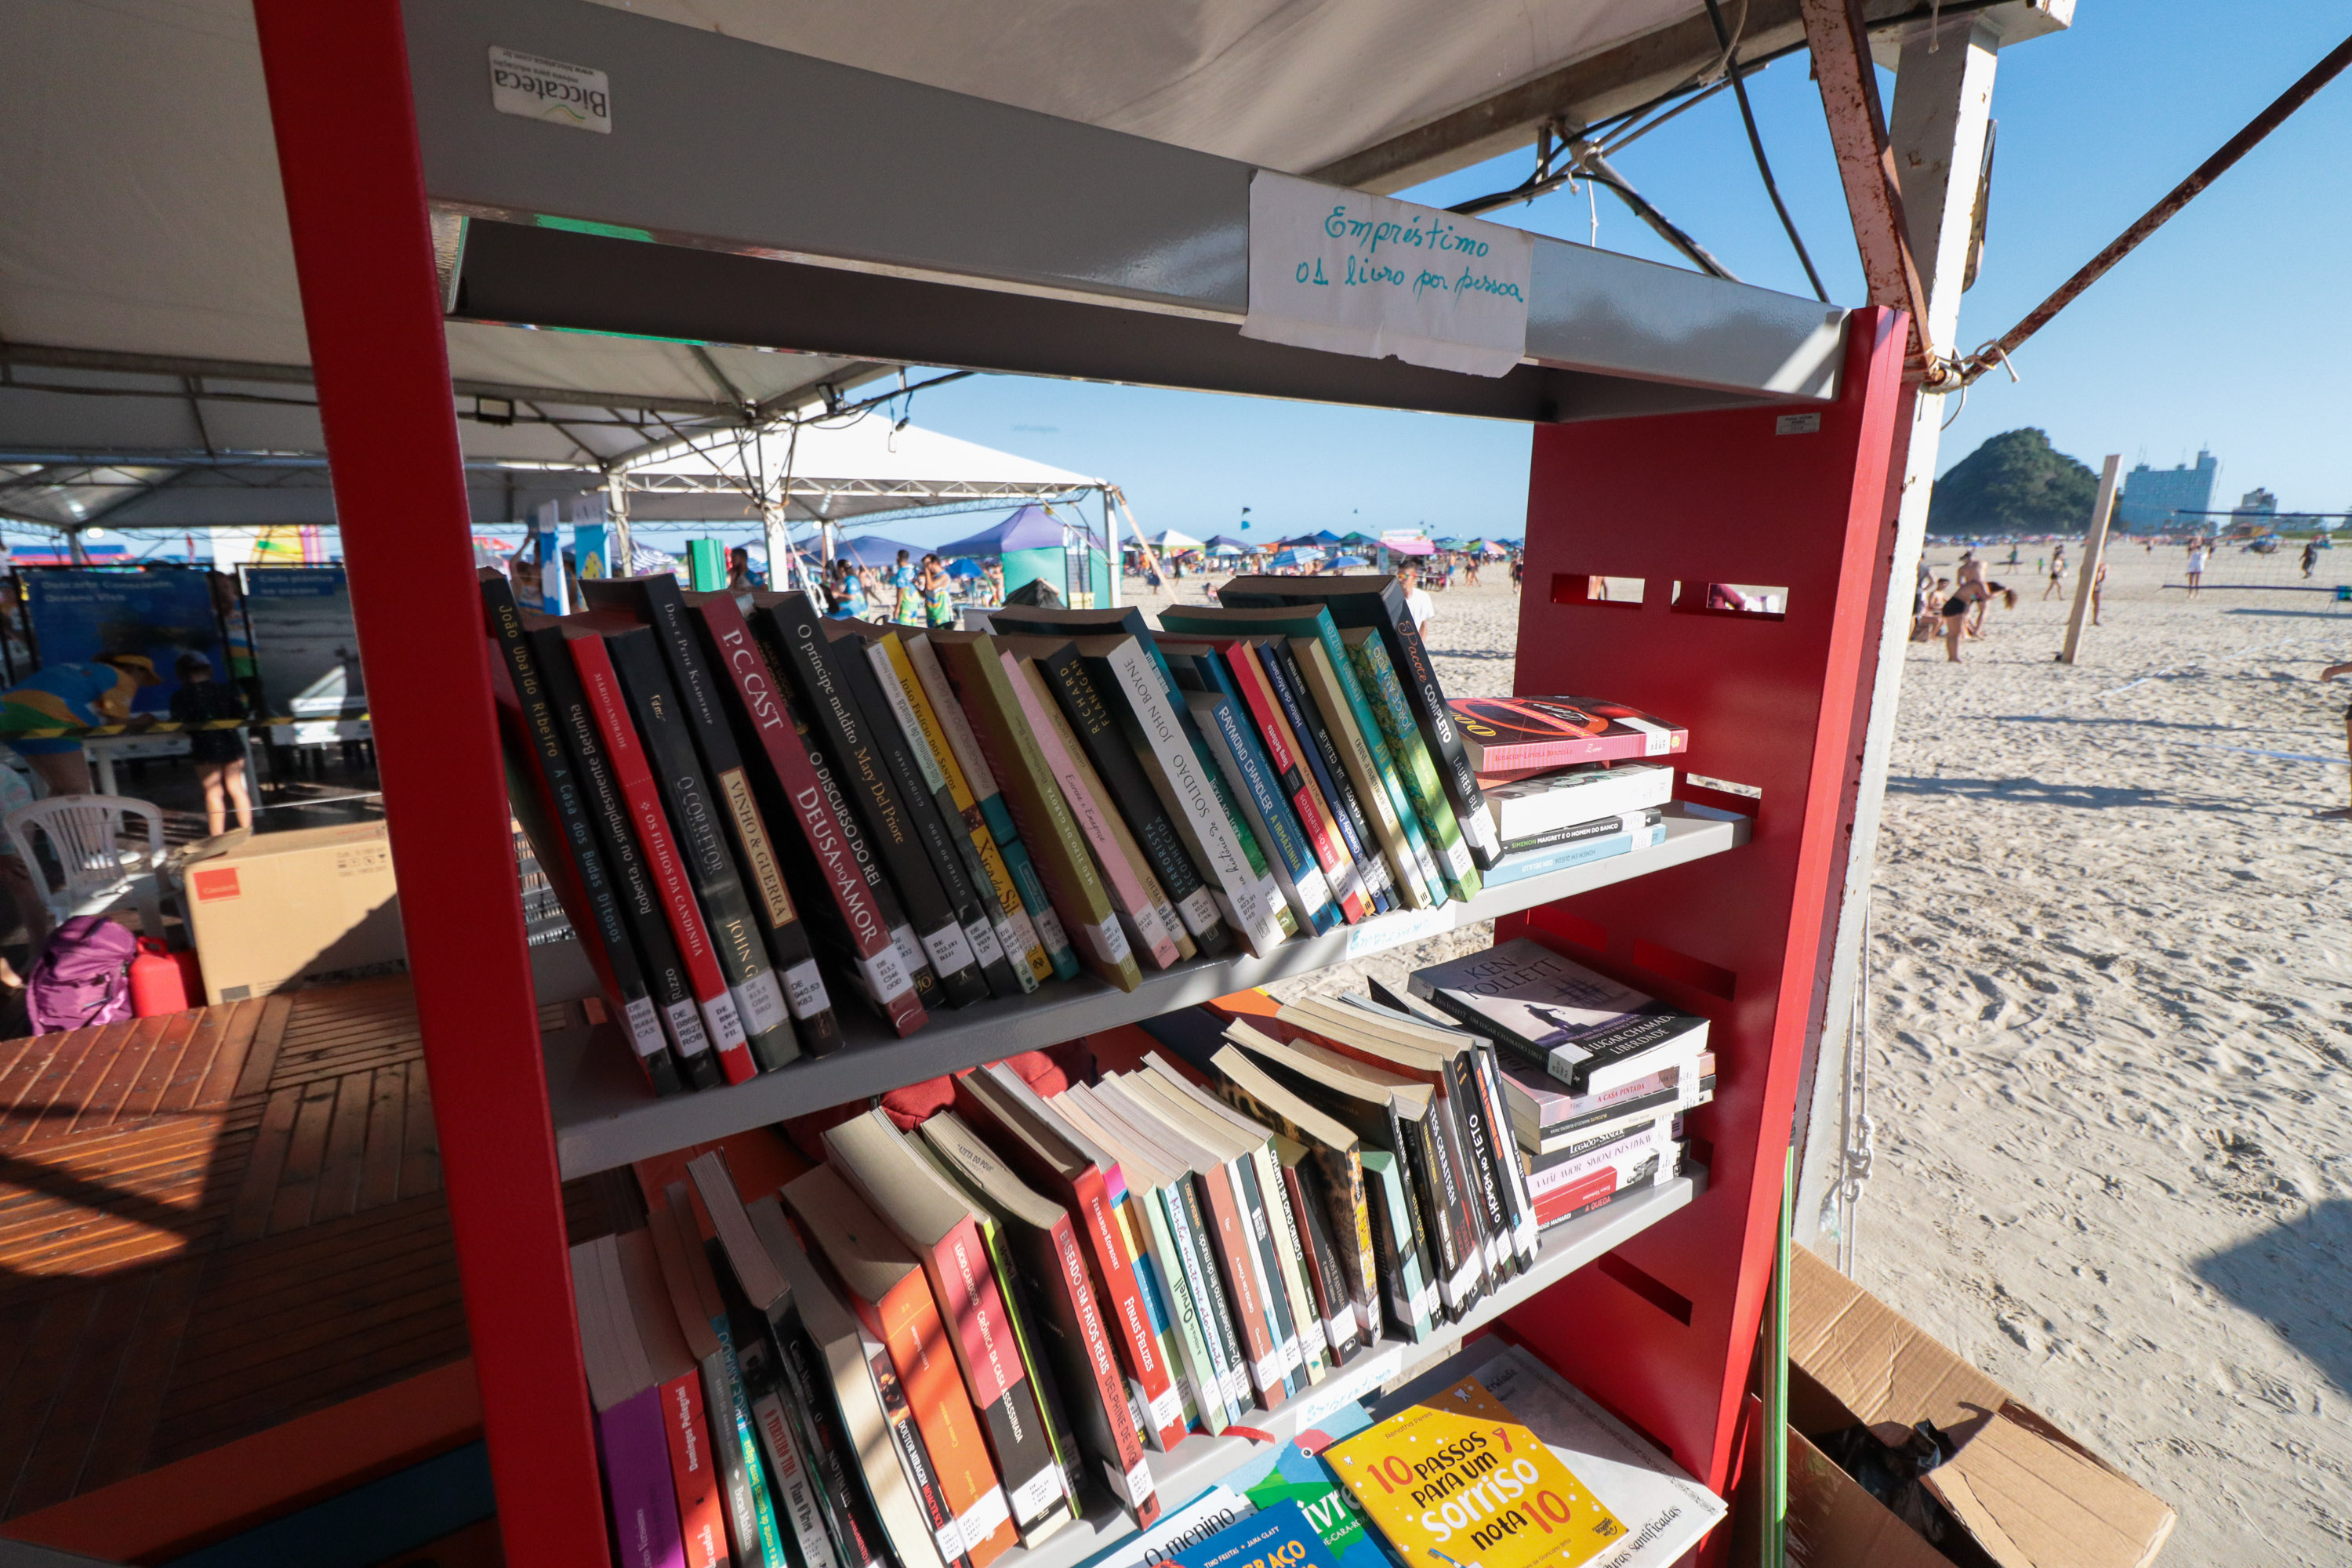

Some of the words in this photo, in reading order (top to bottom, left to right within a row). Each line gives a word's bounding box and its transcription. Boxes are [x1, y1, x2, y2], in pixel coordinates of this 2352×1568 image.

[495, 69, 607, 118] Biccateca
[1325, 206, 1489, 257] Empréstimo
[1345, 256, 1404, 285] livro
[1413, 270, 1447, 304] por
[499, 605, 517, 638] João
[798, 624, 812, 638] O
[1327, 620, 1345, 659] AGUZZOLI
[513, 646, 537, 695] Ubaldo
[800, 642, 834, 695] príncipe
[1124, 659, 1152, 704] BOYNE
[1270, 660, 1286, 692] Moraes
[1344, 662, 1362, 702] FERNANDO
[1374, 648, 1394, 693] AMADO
[744, 673, 784, 729] CAST
[1061, 667, 1100, 734] RICHARD
[1070, 659, 1110, 727] FLANAGAN
[1284, 691, 1292, 702] de
[532, 702, 558, 757] Ribeiro
[571, 704, 596, 755] Betinha
[829, 696, 858, 744] maldito
[1148, 706, 1174, 743] JOHN
[1290, 702, 1302, 728] Heitor
[1392, 694, 1411, 731] JORGE
[1219, 706, 1248, 761] RAYMOND
[1268, 724, 1283, 752] Bellotto
[1319, 728, 1337, 763] CIDADE
[1425, 684, 1452, 744] COMPLETO
[1453, 756, 1472, 796] LAUREN
[554, 769, 567, 778] A
[854, 746, 876, 782] Mary
[895, 750, 909, 777] VIARO
[1279, 750, 1289, 768] Tony
[871, 782, 887, 807] Del
[901, 678, 914, 702] JOÃO
[913, 703, 931, 737] FELÍCIO
[929, 739, 940, 756] DOS
[938, 758, 956, 789] SANTOS
[978, 837, 996, 878] Xica
[908, 780, 924, 807] GUIDO
[1173, 754, 1210, 818] SOLIDÃO
[1243, 759, 1273, 815] CHANDLER
[560, 784, 577, 815] Casa
[590, 757, 627, 843] simplesmente
[1046, 787, 1065, 823] GAROTA
[1345, 784, 1362, 819] GAROTA
[572, 823, 587, 844] dos
[607, 707, 626, 750] ANDRADE
[645, 815, 659, 830] OS
[652, 833, 674, 875] FILHOS
[668, 877, 681, 894] DA
[675, 895, 703, 957] CANDINHA
[810, 752, 822, 765] O
[817, 767, 857, 838] DISCURSO
[851, 839, 869, 862] DO
[863, 863, 880, 887] REI
[883, 806, 904, 844] Priore
[928, 823, 942, 848] MEDO
[1064, 826, 1073, 840] DE
[1270, 815, 1277, 824] A
[1340, 821, 1360, 854] Givenchy
[1512, 840, 1537, 848] SIMENON
[1537, 835, 1561, 844] MAIGRET
[1571, 829, 1591, 838] HOMEM
[1600, 823, 1618, 832] BANCO
[621, 844, 633, 861] ou
[729, 781, 757, 834] VINHO
[750, 839, 760, 849] &
[756, 853, 786, 918] GUERRA
[1071, 841, 1086, 864] TIPO
[1144, 824, 1183, 895] TERRORISTA
[1273, 822, 1301, 872] IRMÃZINHA
[583, 851, 603, 887] Budas
[683, 793, 723, 876] CORRETOR
[725, 919, 753, 963] JOHN
[948, 864, 962, 888] LIVRO
[628, 862, 652, 915] Roberta,
[597, 893, 621, 942] Ditosos
[790, 980, 804, 992] DE
[1457, 957, 1564, 1000] FOLLETT
[1465, 956, 1518, 981] KEN
[793, 982, 820, 1000] 940.53
[672, 1010, 687, 1020] DE
[1592, 1032, 1626, 1051] LUGAR
[1624, 1011, 1678, 1040] CHAMADO
[1610, 1028, 1669, 1054] LIBERDADE
[1603, 1091, 1618, 1101] CASA
[1620, 1083, 1645, 1097] PINTADA
[1469, 1114, 1484, 1157] TETO
[1271, 1149, 1283, 1185] LAMPIÃO
[1429, 1103, 1443, 1135] TESS
[1437, 1137, 1457, 1207] GERRITSEN
[1481, 1156, 1488, 1170] NO
[1279, 1185, 1287, 1197] DE
[1483, 1171, 1500, 1215] HOMEM
[1283, 1197, 1294, 1225] OLHO
[1550, 1214, 1571, 1226] MAINARDI
[1592, 1196, 1611, 1210] QUEDA
[1199, 1233, 1210, 1260] mundo
[1289, 1225, 1301, 1252] OUTRO
[1414, 1223, 1425, 1247] Toda
[954, 1243, 967, 1276] LÚCIO
[1060, 1229, 1082, 1287] BASEADO
[1296, 1252, 1303, 1261] O
[961, 1270, 979, 1306] CARDOSO
[1077, 1286, 1088, 1306] EM
[1092, 1196, 1107, 1236] FERNANDO
[1104, 1232, 1119, 1270] KOPROSKI
[1123, 1296, 1142, 1334] FINAIS
[1136, 1330, 1154, 1372] FELIZES
[1170, 1197, 1186, 1242] Minha
[1183, 1247, 1196, 1283] mente
[1195, 1285, 1203, 1305] me
[1200, 1308, 1221, 1368] atormenta
[1174, 1277, 1192, 1322] Orwell
[1333, 1272, 1346, 1308] FANTASIAS
[977, 1310, 993, 1352] CRÔNICA
[1082, 1305, 1099, 1342] FATOS
[1217, 1297, 1232, 1333] aventura
[989, 1348, 998, 1364] DA
[1094, 1341, 1110, 1375] REAIS
[993, 1363, 1006, 1388] CASA
[676, 1386, 691, 1429] Pellegrini
[1000, 1387, 1023, 1443] ASSASSINADA
[1105, 1376, 1126, 1428] DELPHINE
[767, 1416, 791, 1457] TERCEIRO
[1120, 1428, 1131, 1443] DE
[1385, 1423, 1414, 1440] Renatha
[1413, 1412, 1433, 1427] Peres
[684, 1430, 698, 1472] Domingos
[779, 1455, 797, 1479] TIRA
[897, 1419, 916, 1454] DOUTOR
[909, 1450, 929, 1486] MIRAGEM
[922, 1483, 940, 1514] MOACYR
[1367, 1456, 1414, 1494] 10
[1414, 1431, 1488, 1480] PASSOS
[735, 1485, 744, 1511] Bocas
[789, 1481, 804, 1505] Flann
[1421, 1458, 1539, 1542] sorriso
[796, 1504, 814, 1533] O'Brien
[1521, 1490, 1571, 1534] 10
[1630, 1505, 1682, 1553] santificadas
[698, 1525, 715, 1561] castelo
[739, 1511, 752, 1551] Malditas
[1144, 1548, 1161, 1568] O
[1164, 1508, 1236, 1553] menino
[1204, 1558, 1218, 1568] TINO
[1218, 1548, 1240, 1563] FREITAS
[1247, 1537, 1261, 1548] JANA
[1261, 1526, 1280, 1540] GLATT
